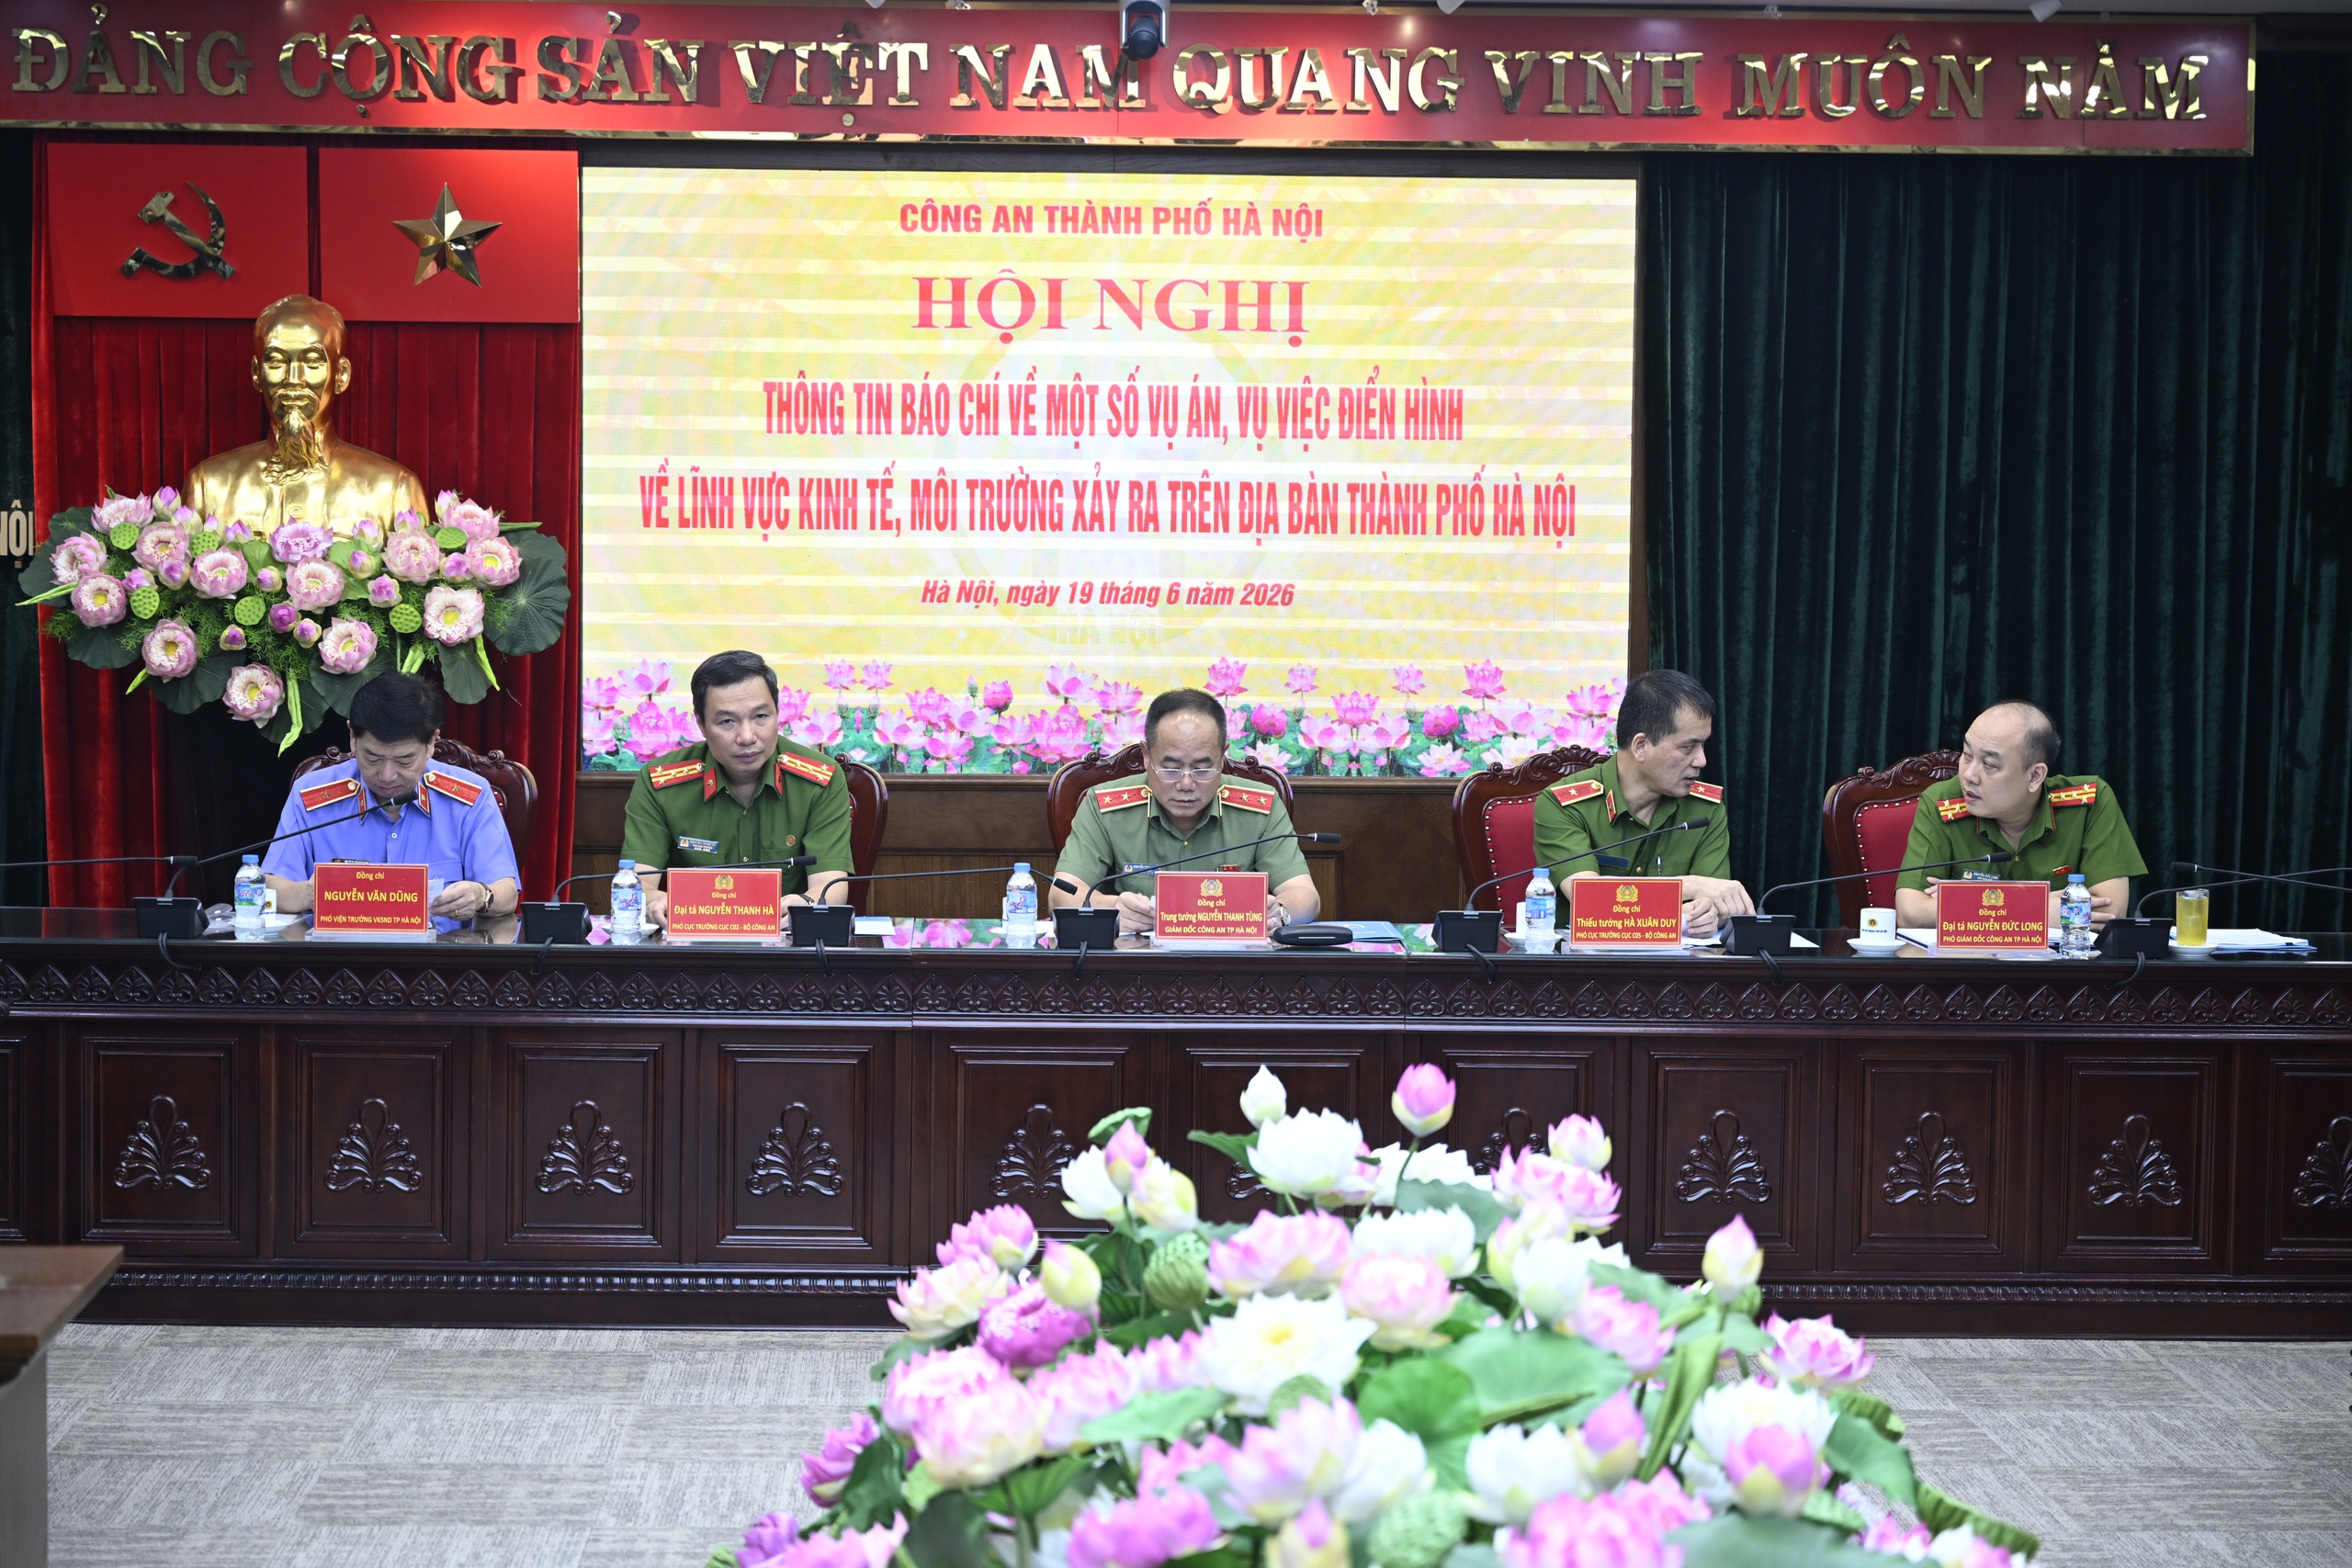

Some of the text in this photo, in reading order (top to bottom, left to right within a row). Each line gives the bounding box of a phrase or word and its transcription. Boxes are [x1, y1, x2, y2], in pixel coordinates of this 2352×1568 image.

[11, 3, 2209, 126] ĐẢNG CỘNG SẢN VIỆT NAM QUANG VINH MUÔN NĂM
[900, 197, 1323, 243] CÔNG AN THÀNH PHỐ HÀ NỘI
[911, 268, 1310, 348] HỘI NGHỊ
[763, 365, 1464, 452] THÔNG TIN BÁO CHÍ VỀ MỘT SỐ VỤ ÁN, VỤ VIỆC ĐIỂN HÌNH
[639, 457, 1576, 549] VỀ LĨNH VỰC KINH TẾ, MÔI TRƯỜNG XẢY RA TRÊN ĐỊA BÀN THÀNH PHỐ HÀ NỘI
[922, 580, 1295, 609] Hà Nội, ngày 19 tháng 6 năm 2026
[356, 871, 373, 880] Đồng
[324, 888, 364, 901] NGUYỄN
[368, 890, 386, 901] VĂN
[390, 891, 418, 902] DŨNG
[674, 902, 774, 916] Đại tá NGUYỄN THANH HÀ
[1197, 898, 1215, 908] Đồng
[1613, 904, 1630, 914] Đồng
[1160, 909, 1262, 923] Trung tướng NGUYỄN THANH TÙNG
[1979, 908, 1996, 917] Đồng
[334, 915, 346, 923] VIỆN
[411, 916, 421, 925] NỘI
[1577, 917, 1676, 929] Thiếu tướng HÀ XUÂN DUY
[1943, 919, 2042, 931] Đại tá NGUYỄN ĐỨC LONG
[1198, 925, 1215, 933] CÔNG
[1246, 926, 1257, 934] NỘI
[1599, 931, 1621, 939] TRƯỞNG
[1645, 931, 1652, 940] BỘ
[1973, 934, 1985, 942] ĐỐC
[1986, 934, 2002, 942] CÔNG
[2031, 935, 2041, 943] NỘI
